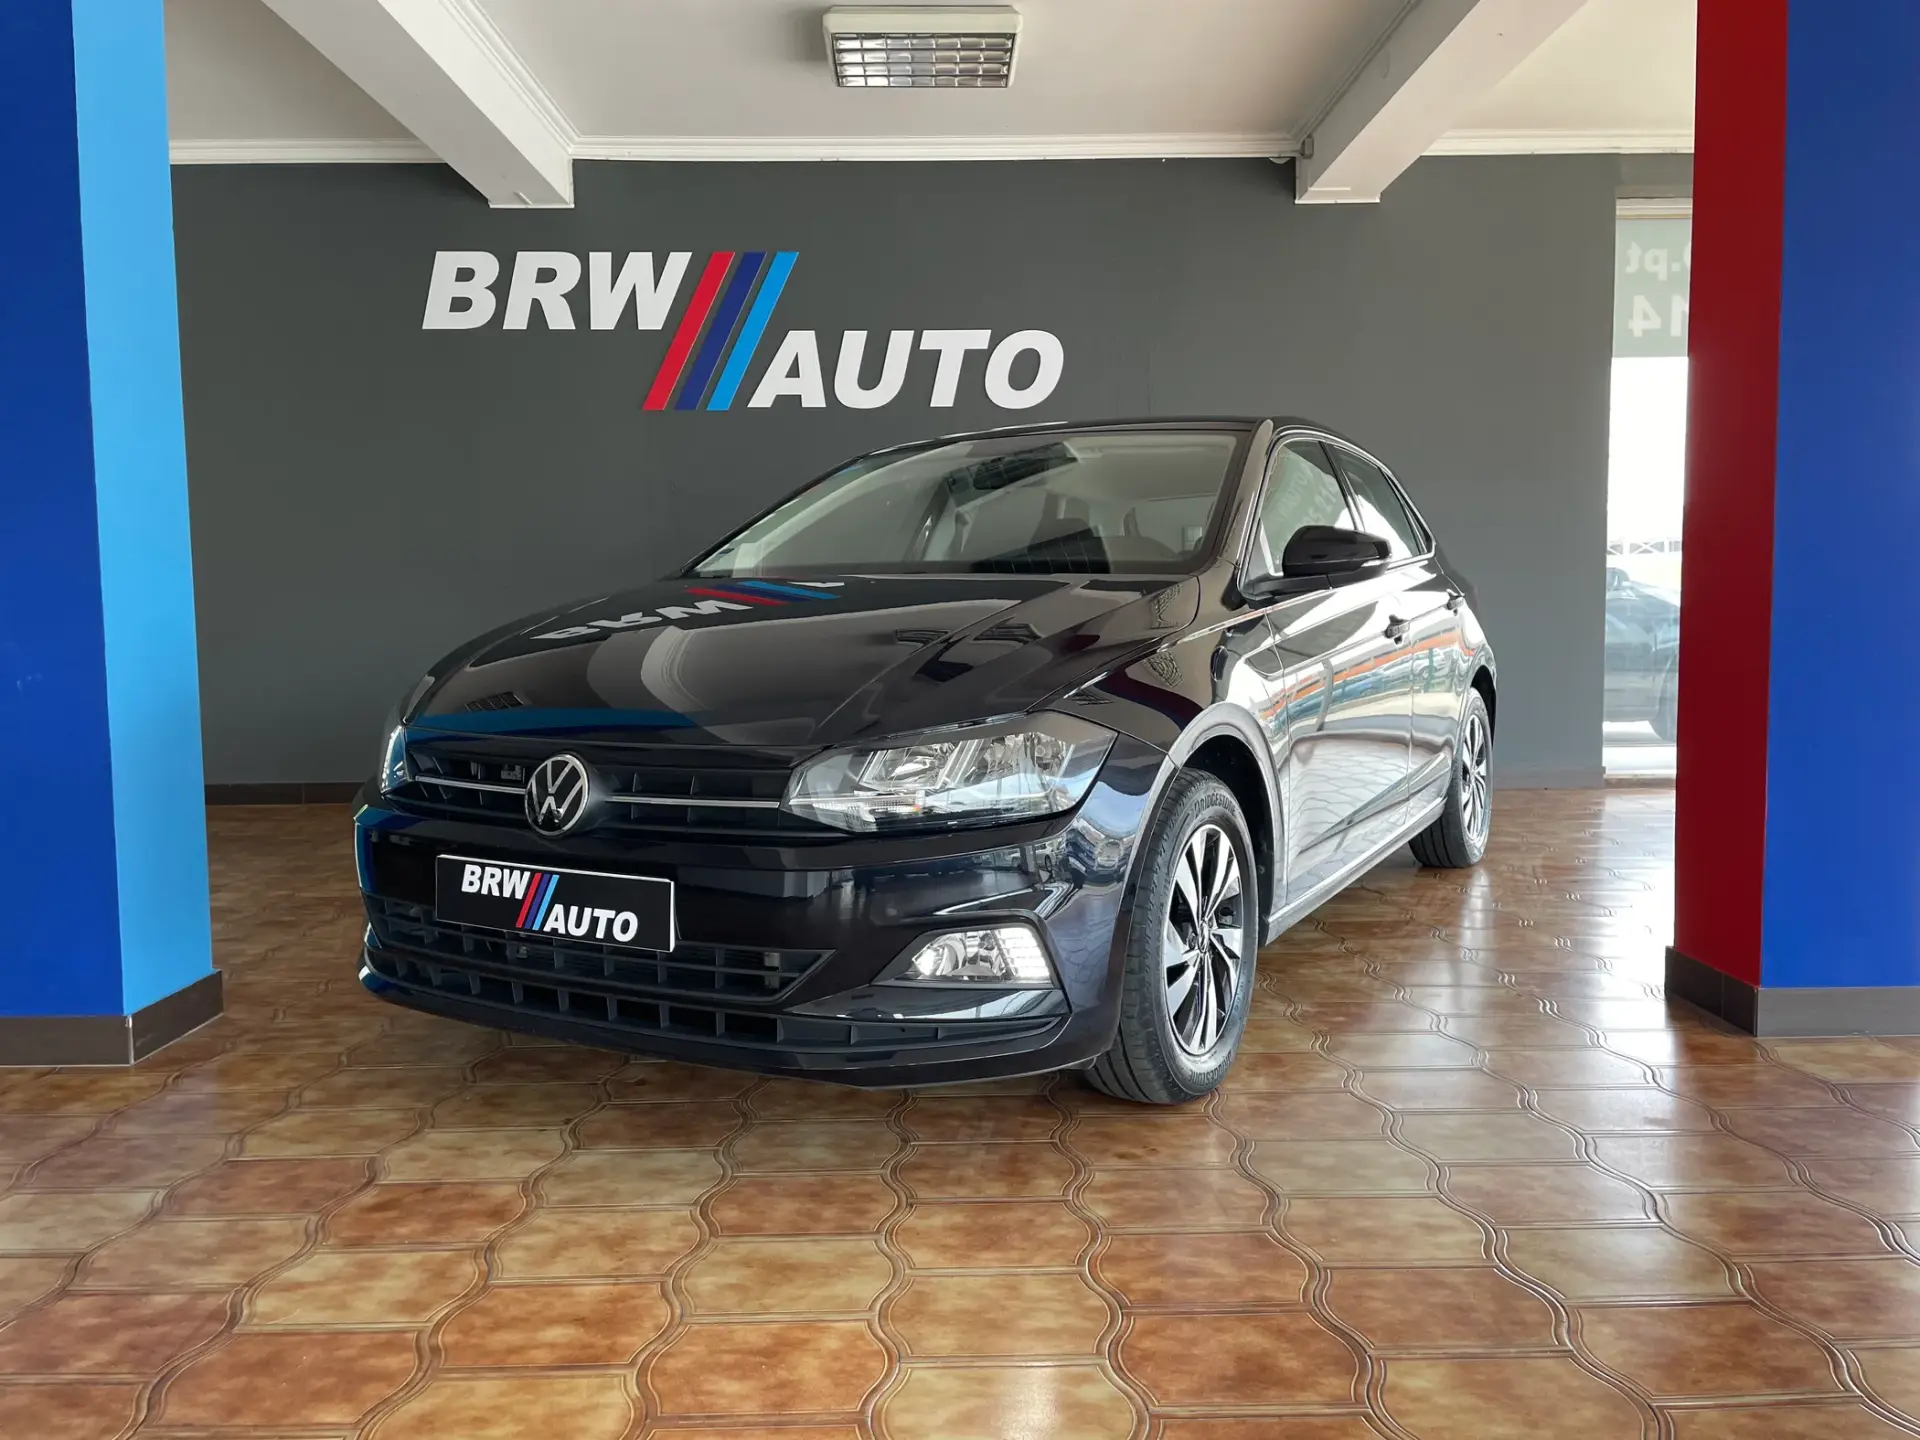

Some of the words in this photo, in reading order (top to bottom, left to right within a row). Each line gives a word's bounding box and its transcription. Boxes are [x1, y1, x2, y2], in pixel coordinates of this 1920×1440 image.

[421, 250, 693, 331] BRW
[746, 328, 1065, 410] AUTO
[461, 863, 531, 900] BRW
[543, 903, 639, 943] AUTO
